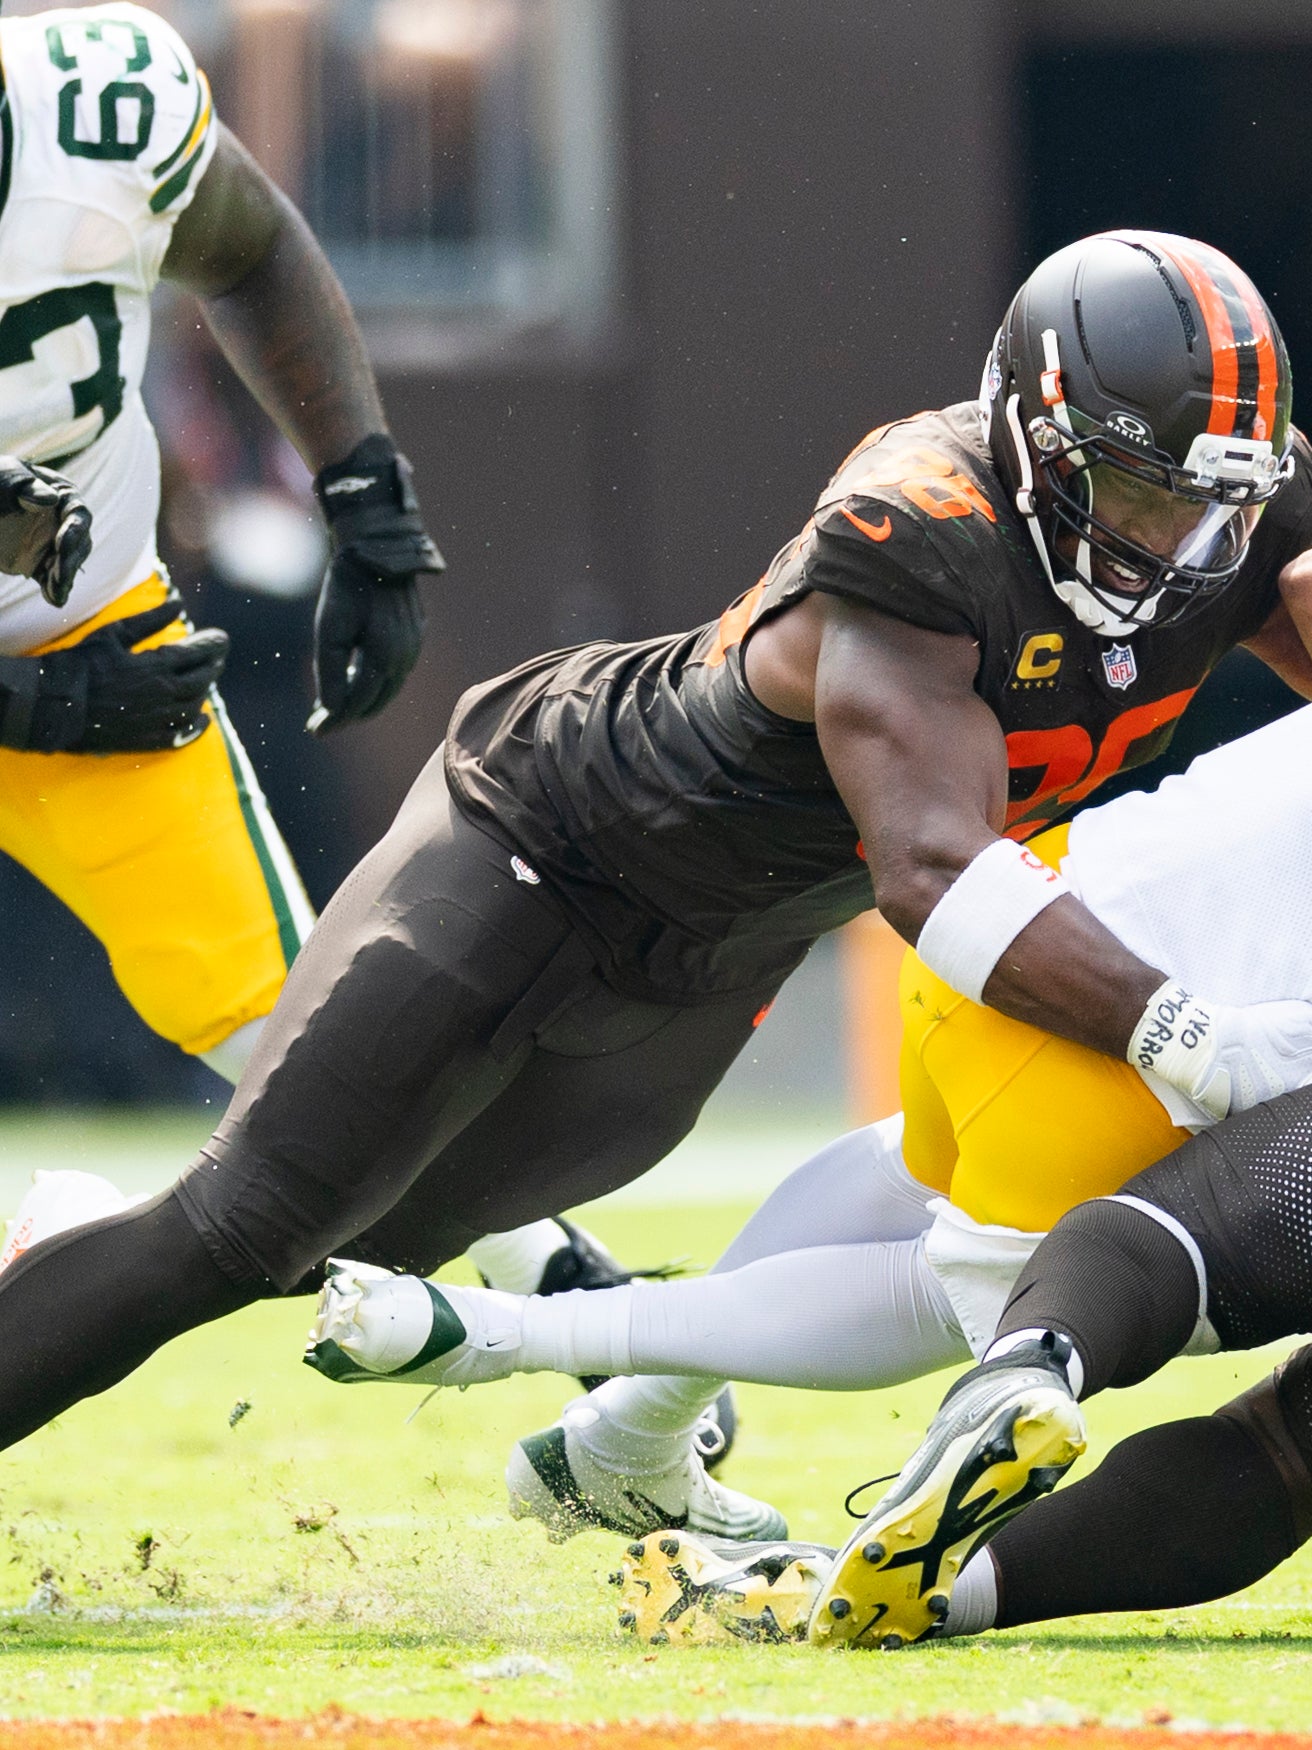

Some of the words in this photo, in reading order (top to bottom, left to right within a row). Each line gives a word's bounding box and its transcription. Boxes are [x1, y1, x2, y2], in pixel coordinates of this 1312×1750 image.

[1106, 420, 1151, 446] OAKLEY
[1016, 635, 1064, 680] C
[1110, 663, 1132, 681] NFL
